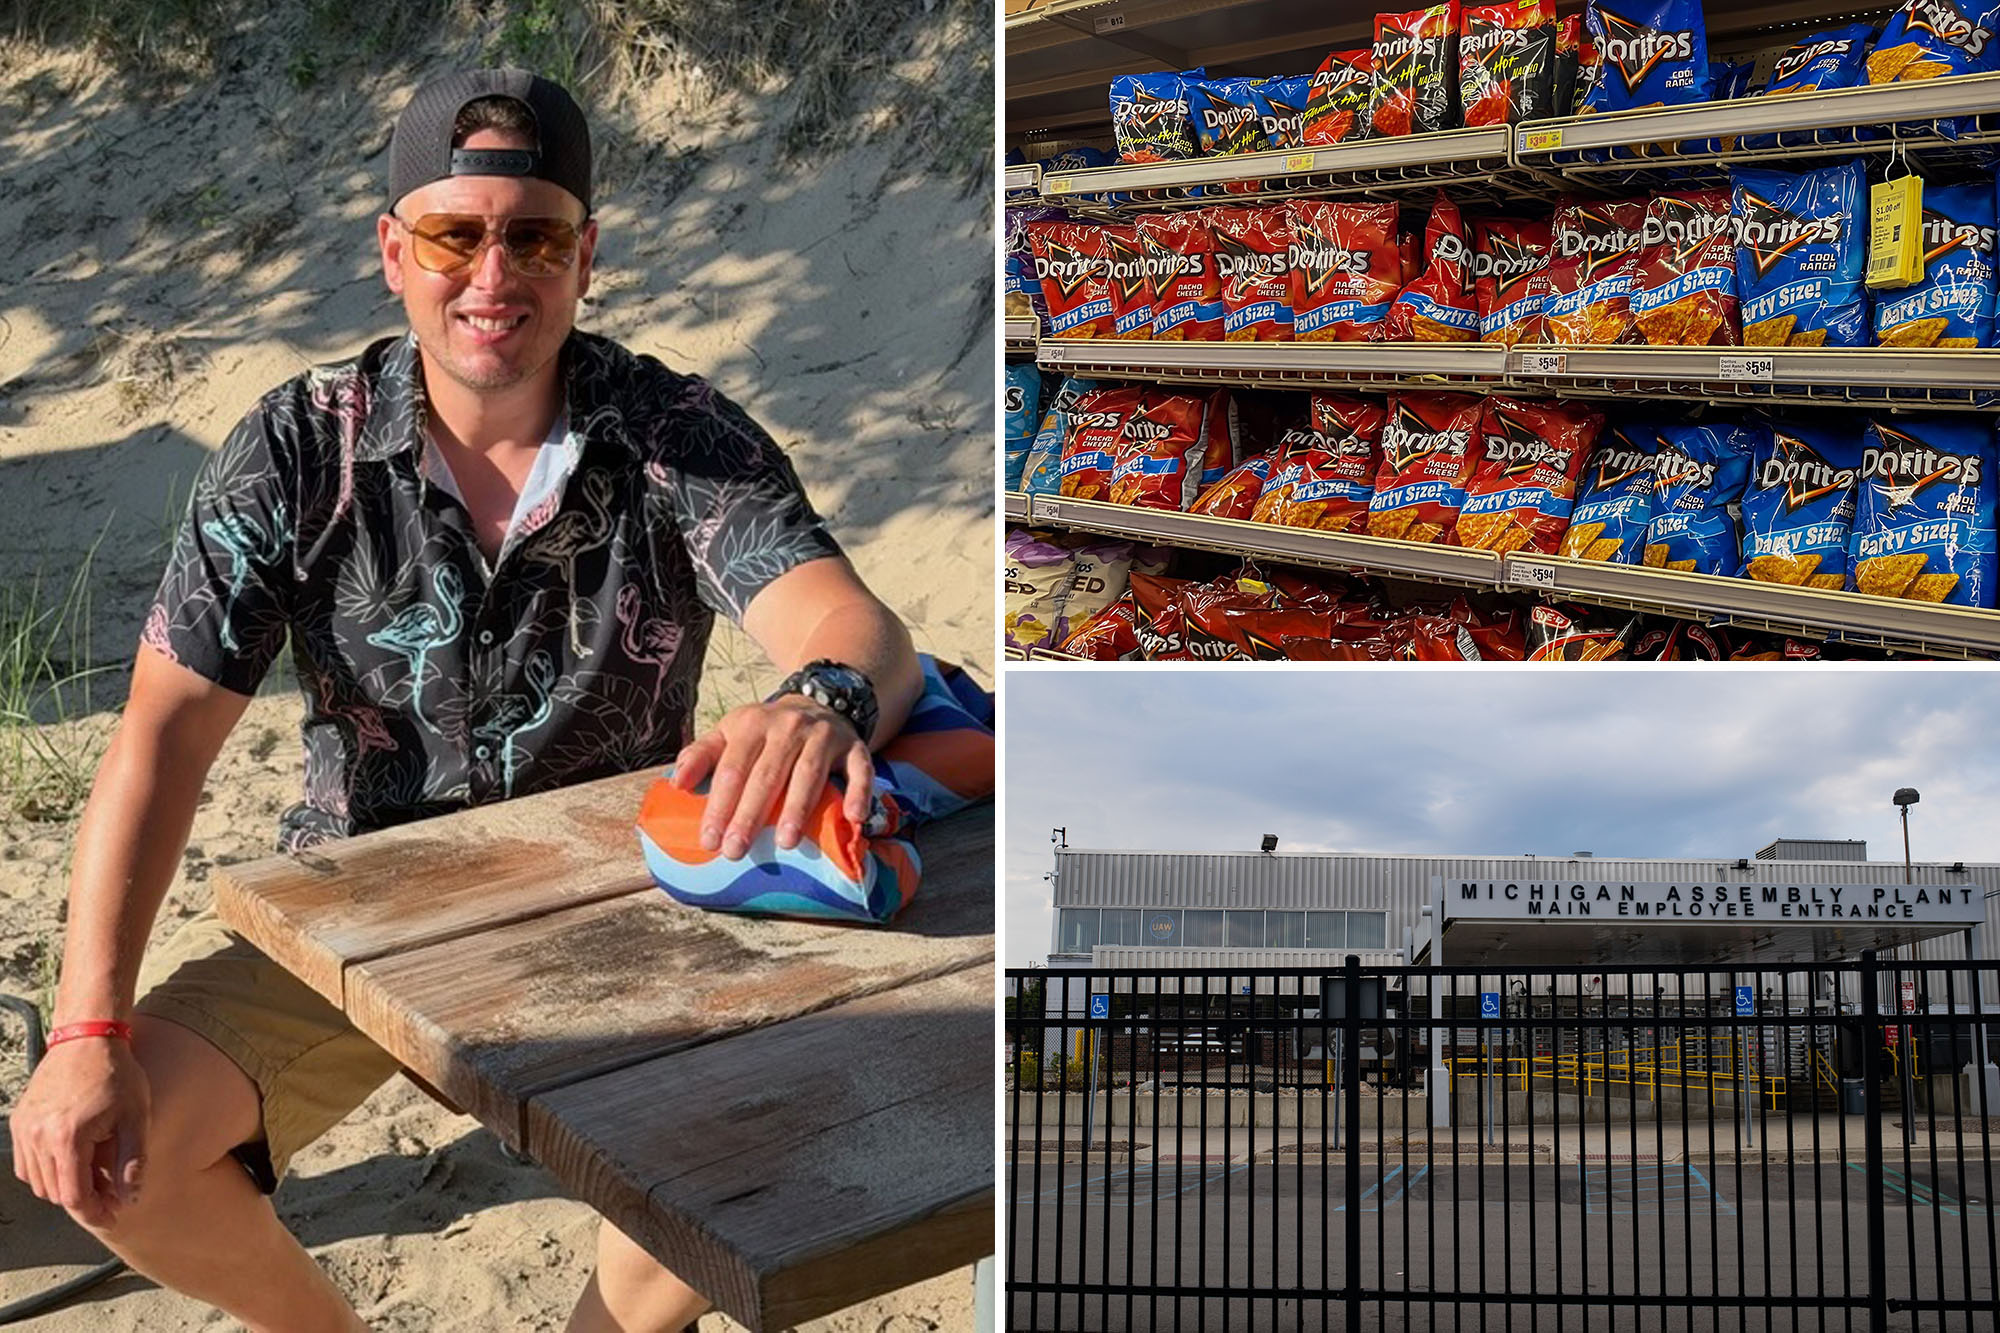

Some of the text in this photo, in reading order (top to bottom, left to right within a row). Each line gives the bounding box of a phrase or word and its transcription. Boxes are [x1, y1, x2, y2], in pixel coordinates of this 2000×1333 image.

[1459, 29, 1529, 57] Doritos
[1775, 39, 1852, 70] oritos
[1400, 63, 1426, 82] Hot
[1493, 55, 1520, 75] Hot
[1512, 63, 1539, 80] NACHO
[1671, 69, 1694, 80] COOL
[1313, 67, 1372, 88] Dorito
[1665, 78, 1695, 88] RANCH
[1341, 91, 1367, 105] Hot
[1117, 100, 1189, 118] Doritos
[1262, 112, 1303, 135] Dori
[1242, 130, 1260, 146] Hot
[1876, 204, 1893, 216] $1.00
[1643, 214, 1730, 246] Dorito
[1922, 218, 1996, 252] ritos
[1562, 227, 1641, 256] Dorito
[1289, 244, 1370, 272] Doritos
[1475, 253, 1551, 276] Dorito
[1799, 262, 1837, 271] RANCH
[1808, 253, 1836, 262] COOL
[1966, 259, 1992, 271] COOL
[1035, 257, 1107, 280] Dorito
[1956, 266, 1993, 279] RANCH
[1332, 288, 1367, 296] CHEESE
[1640, 270, 1724, 308] Party Size!
[1779, 281, 1822, 307] Size!
[1554, 287, 1593, 313] Party
[1052, 300, 1113, 332] Party Size!
[1138, 305, 1152, 322] Siz
[1169, 303, 1195, 323] Size!
[1245, 303, 1276, 324] Size!
[1321, 302, 1354, 322] Size!
[1423, 302, 1466, 326] Party
[1124, 420, 1170, 439] orito
[1381, 426, 1470, 456] Doritos
[1070, 453, 1099, 470] Size!
[1427, 460, 1460, 470] NACHO
[1655, 450, 1716, 488] ritos
[1862, 448, 1982, 484] Doritos
[1423, 468, 1459, 478] CHEESE
[1761, 459, 1855, 489] Dorito
[1316, 481, 1351, 497] Size!
[1369, 483, 1443, 511] Party Size!
[1684, 494, 1705, 504] COOL
[1462, 489, 1544, 513] Party Size!
[1674, 500, 1705, 511] RANCH
[1936, 501, 1976, 515] RANCH
[1656, 516, 1689, 537] Size!
[1805, 525, 1845, 545] Size!
[1859, 522, 1959, 557] Party Size!
[1187, 639, 1242, 659] orito
[1461, 883, 1973, 905] MICHIGAN ASSEMBLY PLANT
[1528, 901, 1914, 918] MAIN EMPLOYEE ENTRANCE
[1152, 923, 1173, 931] UAW
